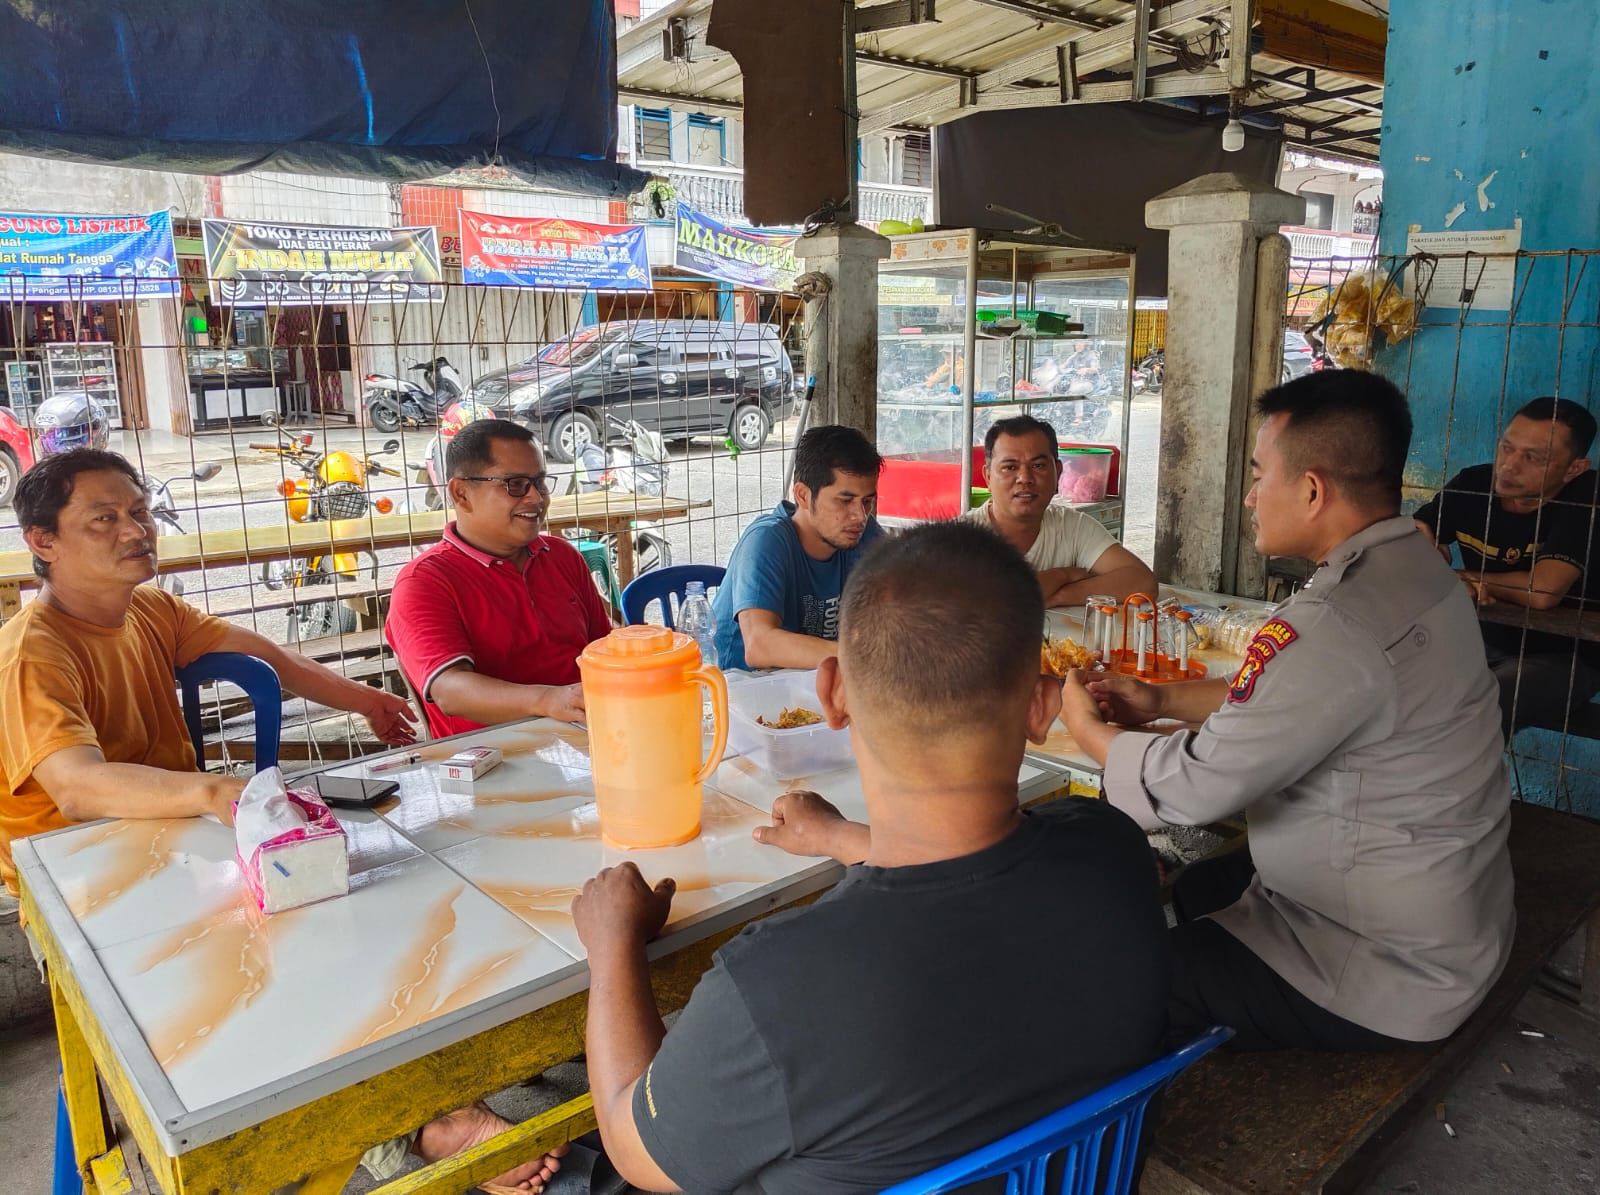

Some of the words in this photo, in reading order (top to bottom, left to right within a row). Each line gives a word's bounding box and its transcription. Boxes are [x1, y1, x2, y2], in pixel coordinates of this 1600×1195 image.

[67, 216, 151, 235] LISTRIK
[244, 226, 291, 239] TOKO
[296, 229, 393, 242] PERHIASAN
[277, 240, 304, 249] JUAL
[307, 241, 331, 250] BELI
[334, 241, 371, 251] PERAK
[21, 253, 64, 264] Rumah
[69, 254, 114, 266] Tangga
[98, 286, 116, 294] 0812
